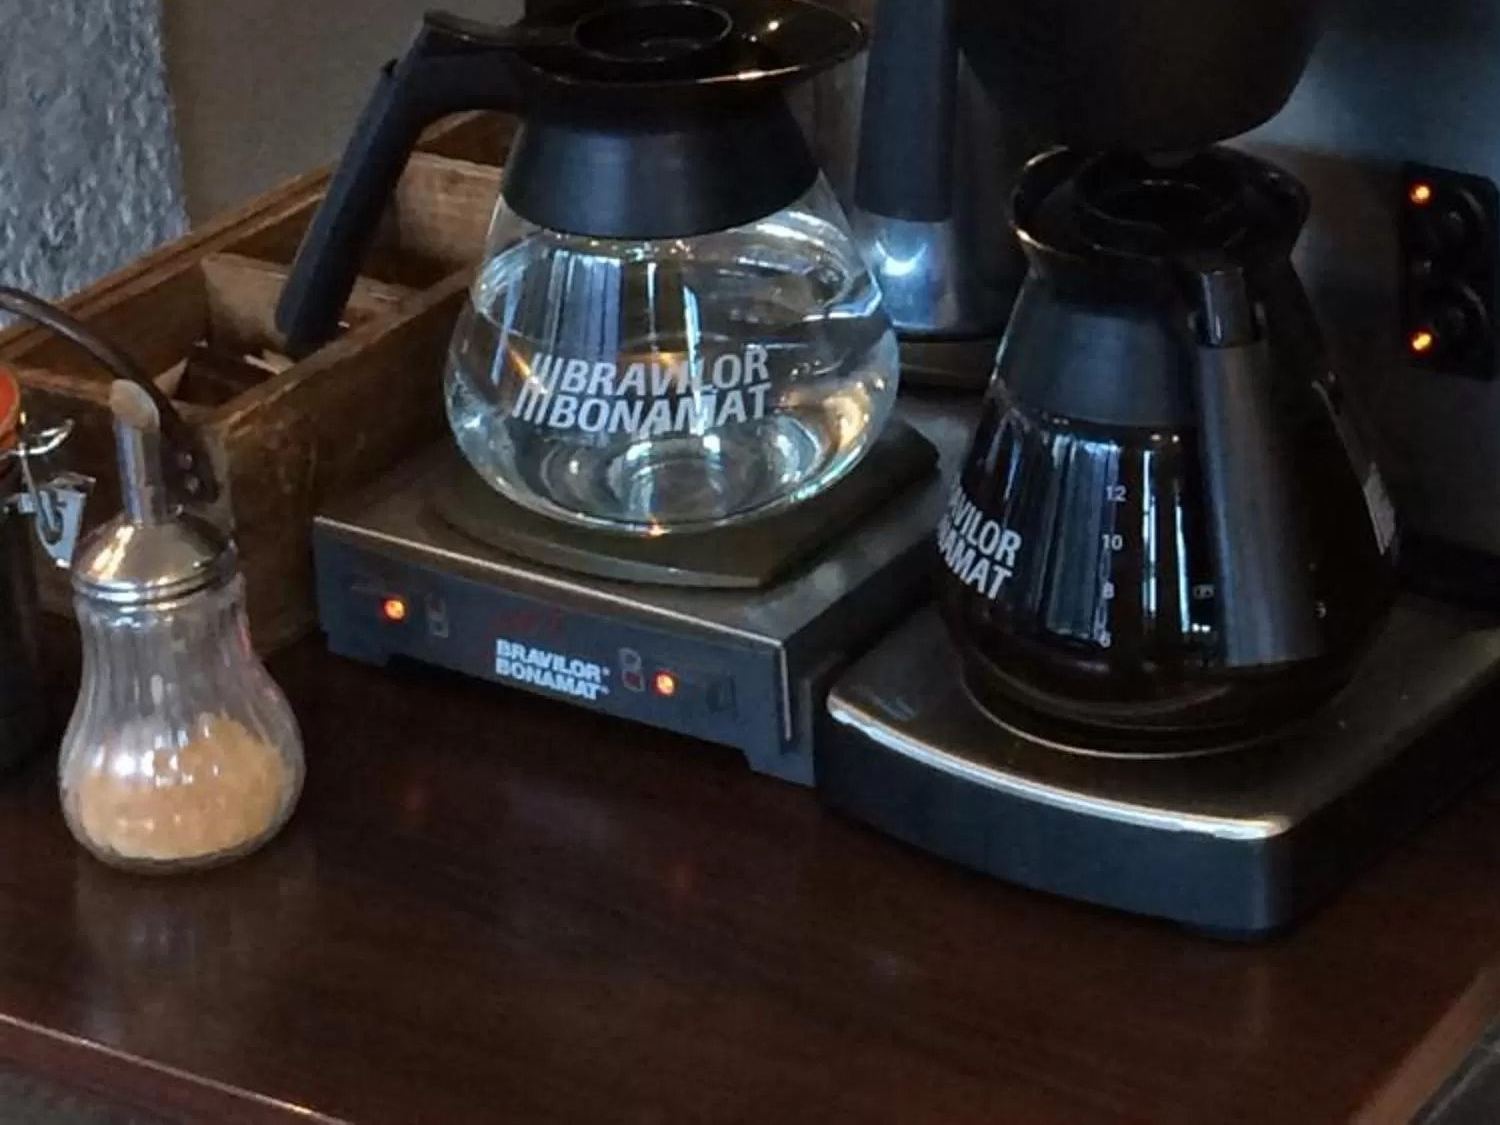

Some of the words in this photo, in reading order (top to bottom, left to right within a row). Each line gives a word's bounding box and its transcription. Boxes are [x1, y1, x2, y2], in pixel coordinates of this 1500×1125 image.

[560, 344, 769, 396] BRAVILOR
[550, 382, 772, 438] BONAMAT
[1106, 485, 1127, 502] 12
[1103, 534, 1123, 550] 10
[496, 639, 602, 683] BRAVILOR
[496, 658, 602, 700] BONAMAT
